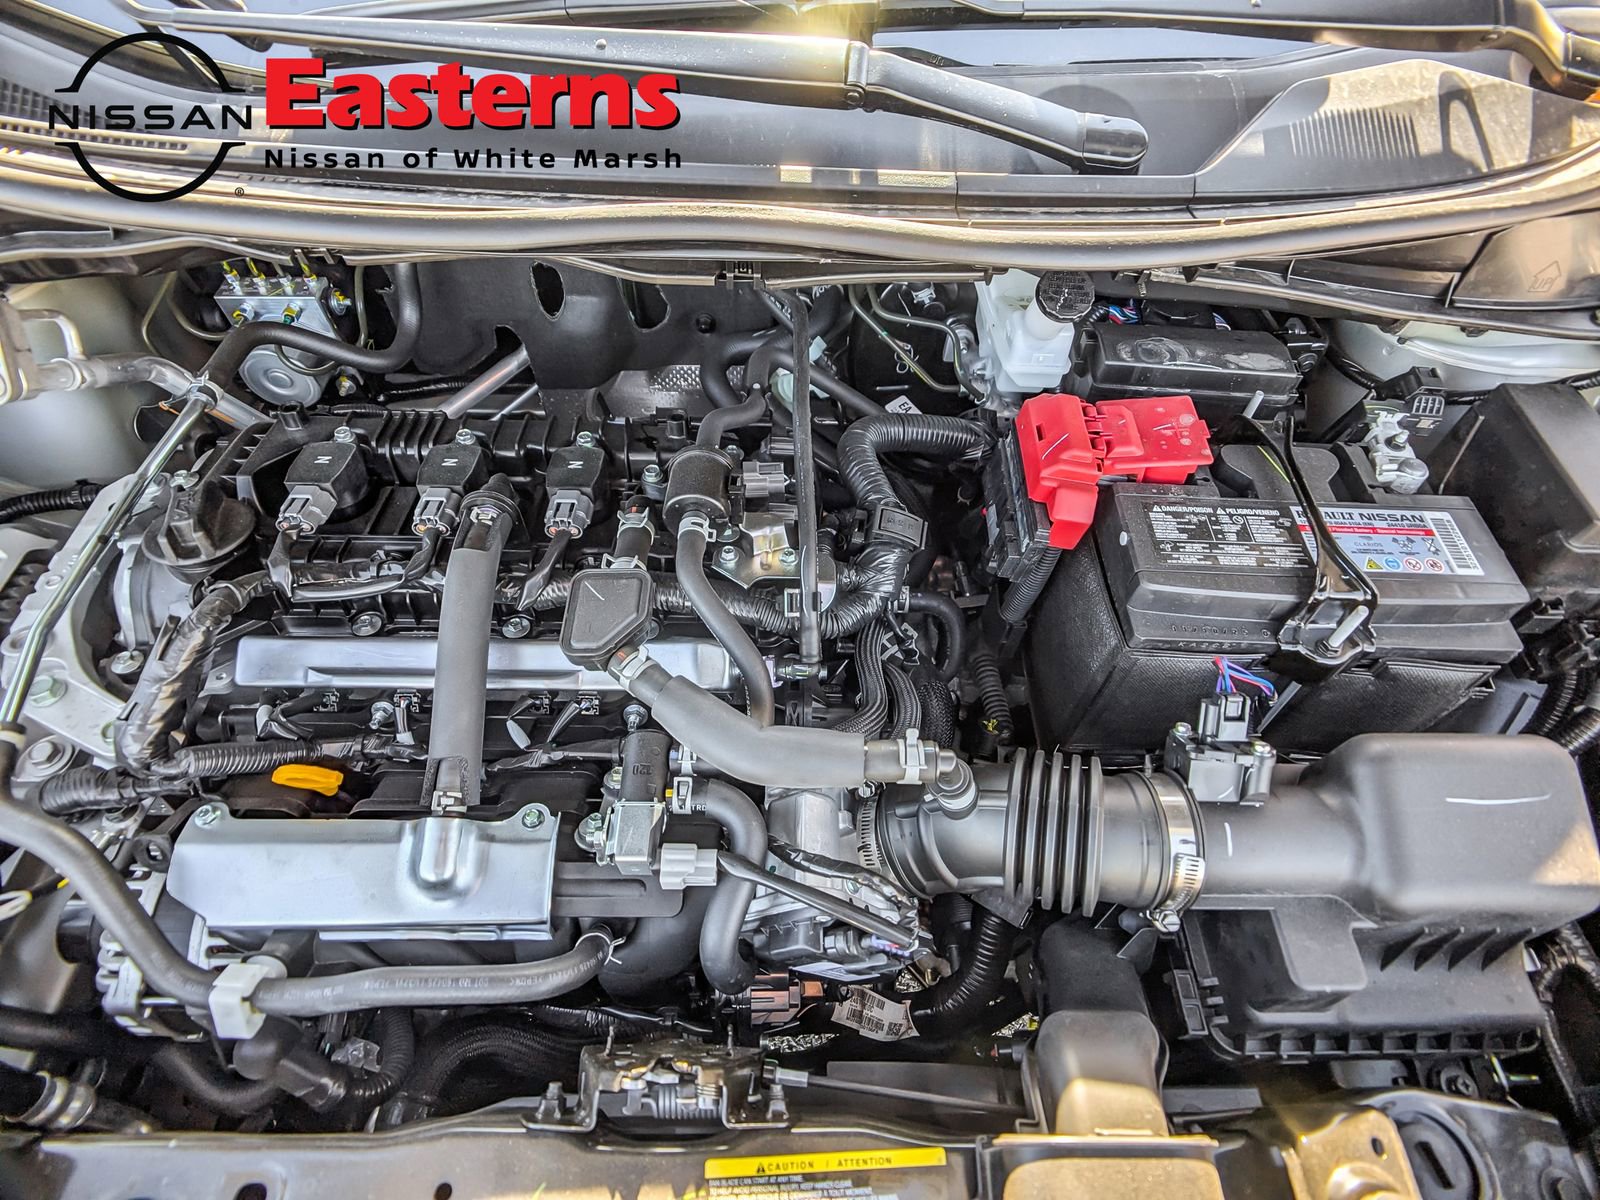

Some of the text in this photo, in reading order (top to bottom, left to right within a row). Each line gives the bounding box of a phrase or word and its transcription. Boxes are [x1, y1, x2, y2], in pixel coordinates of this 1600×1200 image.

[1161, 505, 1214, 514] DANGER/POISON
[1295, 510, 1425, 523] RAULT NISSAN
[767, 1161, 814, 1172] CAUTION
[837, 1156, 892, 1168] ATTENTION
